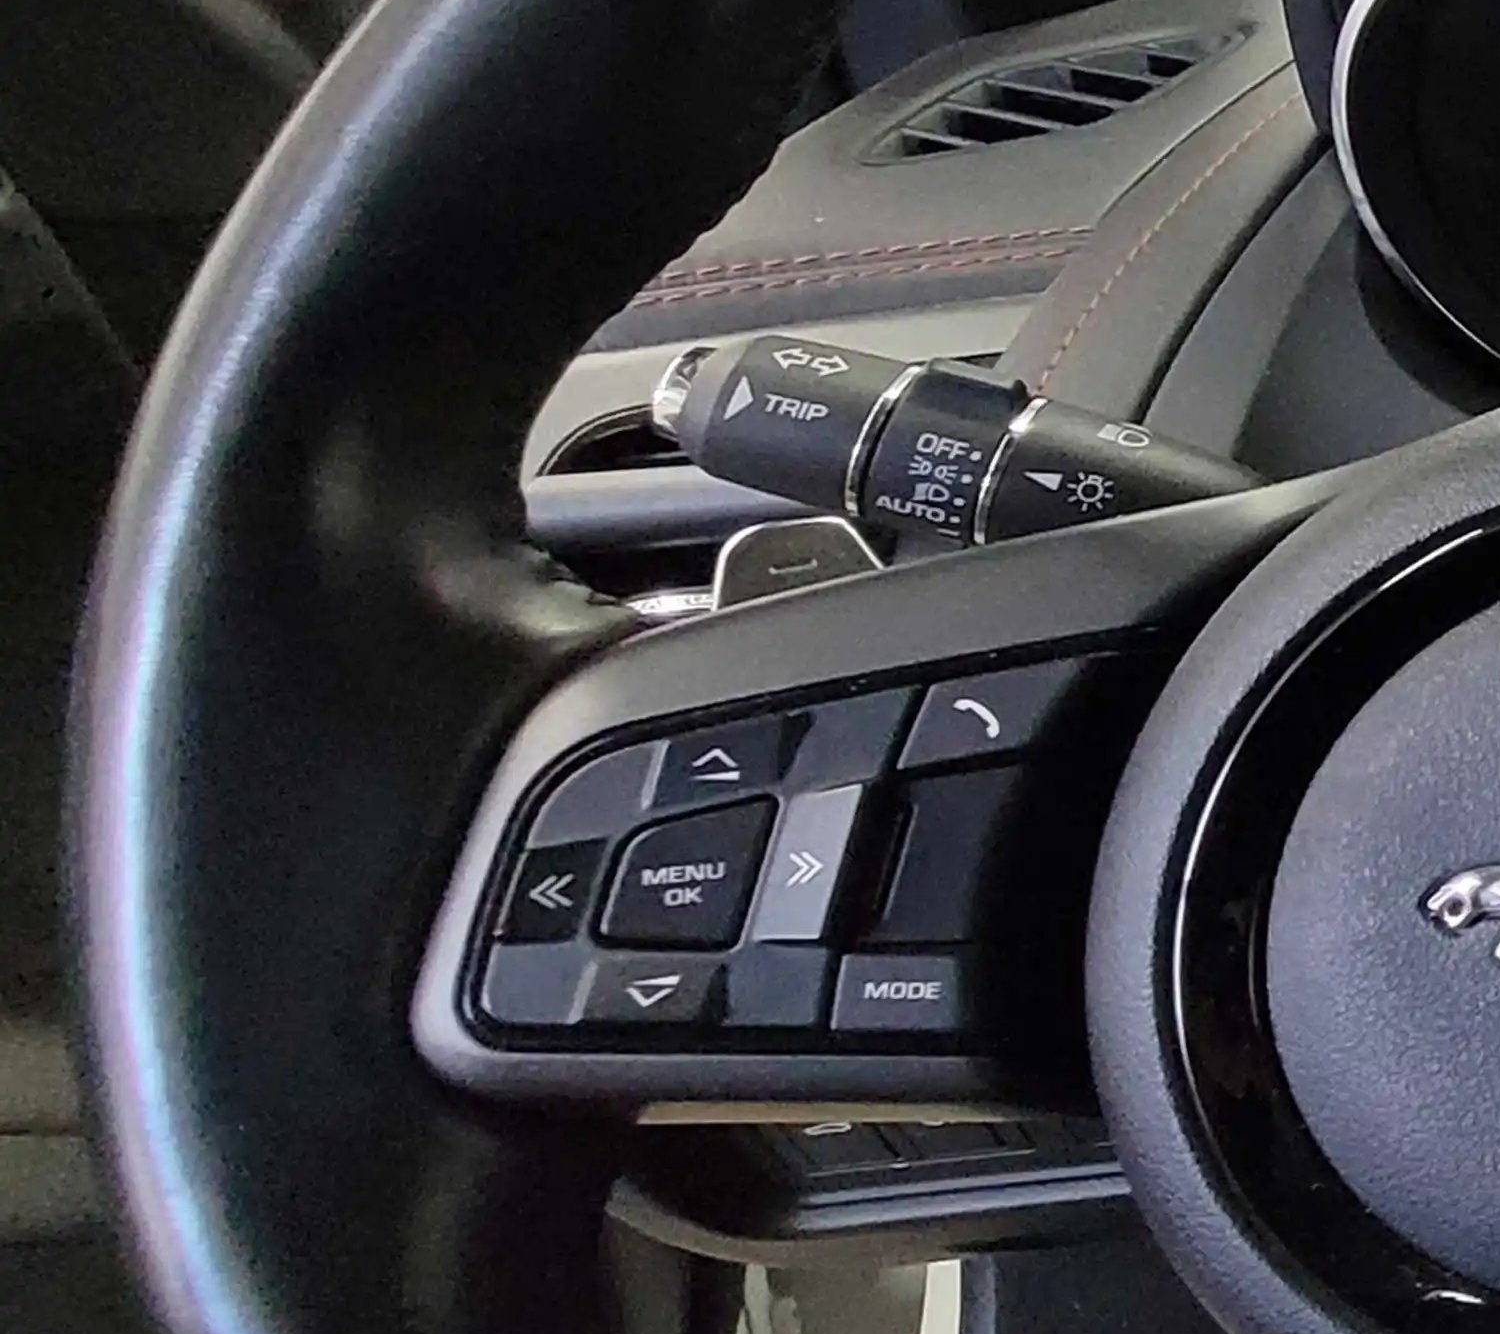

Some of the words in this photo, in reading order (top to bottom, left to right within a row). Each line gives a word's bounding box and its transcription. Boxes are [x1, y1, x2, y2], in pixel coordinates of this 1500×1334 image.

[764, 393, 829, 421] TRIP
[916, 433, 969, 459] OFF
[875, 495, 946, 523] AUTO
[641, 861, 725, 886] MENU
[663, 886, 703, 907] OK
[863, 981, 942, 999] MODE
